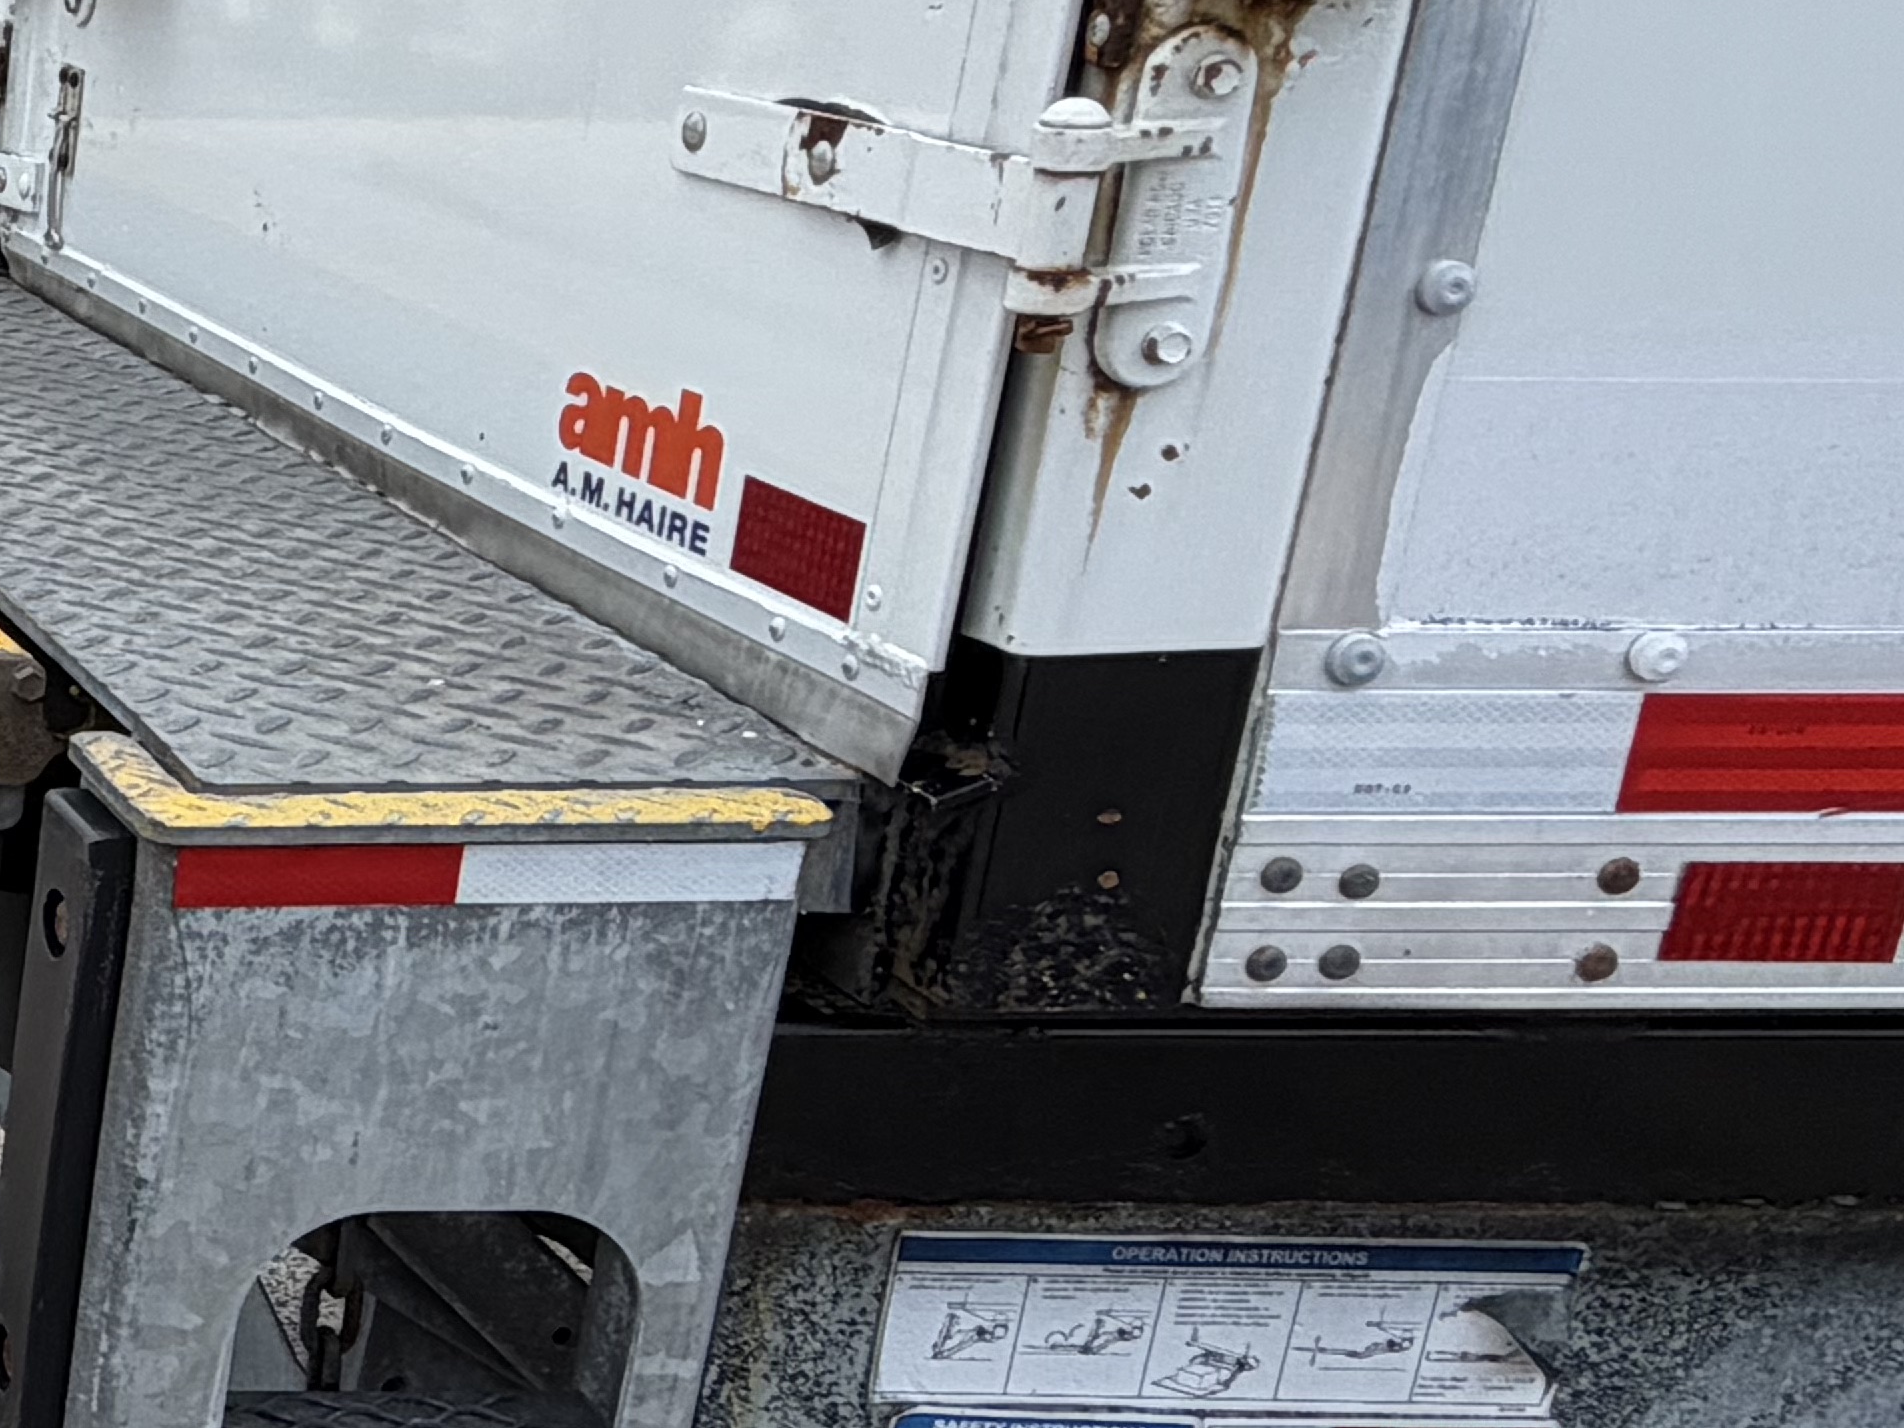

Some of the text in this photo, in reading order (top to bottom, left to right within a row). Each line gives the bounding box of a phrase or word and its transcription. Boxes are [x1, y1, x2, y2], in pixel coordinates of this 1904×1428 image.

[558, 371, 725, 512] amh
[614, 486, 711, 558] HAIRE
[1112, 1245, 1370, 1266] OPERATION INSTRUCTIONS
